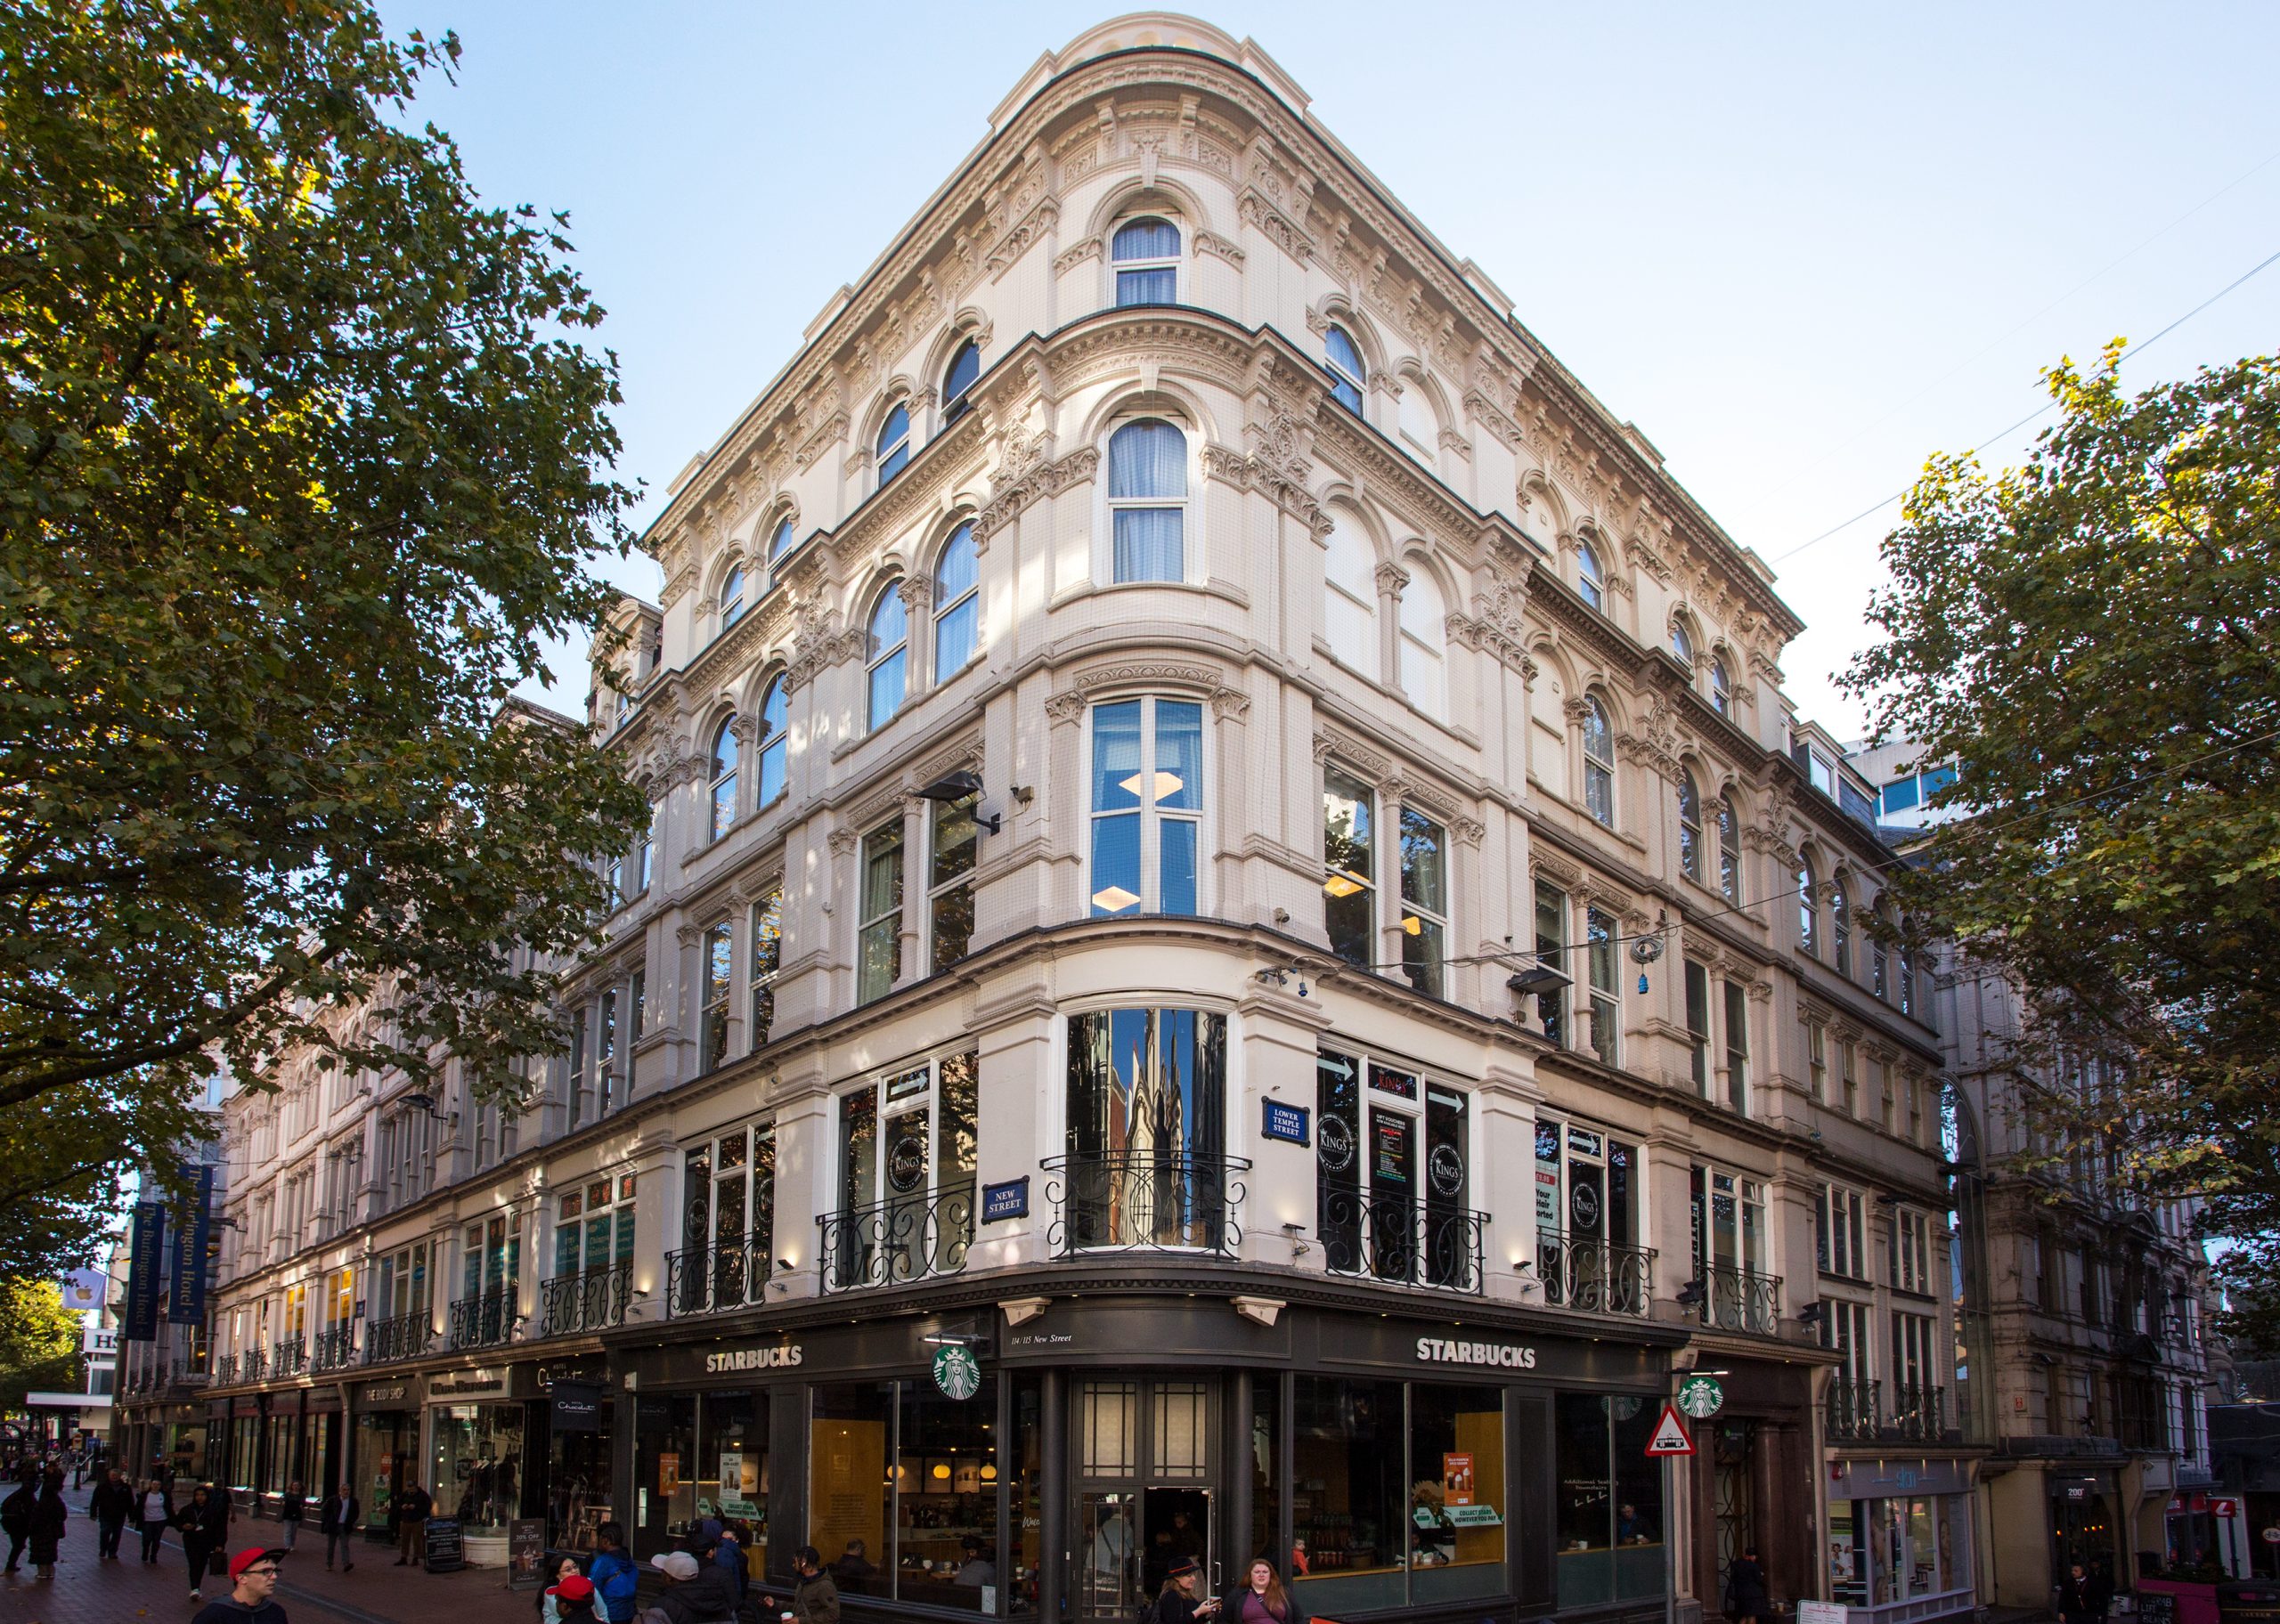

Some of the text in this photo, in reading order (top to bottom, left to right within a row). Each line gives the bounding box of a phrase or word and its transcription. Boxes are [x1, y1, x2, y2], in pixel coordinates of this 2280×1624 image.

[1274, 1108, 1299, 1121] LOWER
[1273, 1116, 1299, 1129] TEMPLE
[1273, 1124, 1299, 1136] STREET
[1321, 1134, 1347, 1151] KINGS
[896, 1156, 919, 1172] KINGS
[1436, 1164, 1459, 1179] KINGS
[996, 1190, 1015, 1202] NEW
[1535, 1189, 1551, 1199] Your
[989, 1198, 1022, 1213] STREET
[1536, 1199, 1550, 1209] Hair
[1576, 1200, 1594, 1213] KINGS
[1536, 1211, 1553, 1220] orted
[181, 1197, 200, 1265] Brlington
[136, 1230, 155, 1290] Burlington
[180, 1271, 196, 1307] Hotel
[135, 1293, 151, 1326] Hotel
[1011, 1334, 1072, 1345] 114/115 New Street
[706, 1345, 802, 1373] STARBUCKS
[1416, 1337, 1535, 1368] STARBUCKS
[366, 1387, 406, 1401] THE BODY SHOP
[558, 1401, 597, 1411] Chocolat
